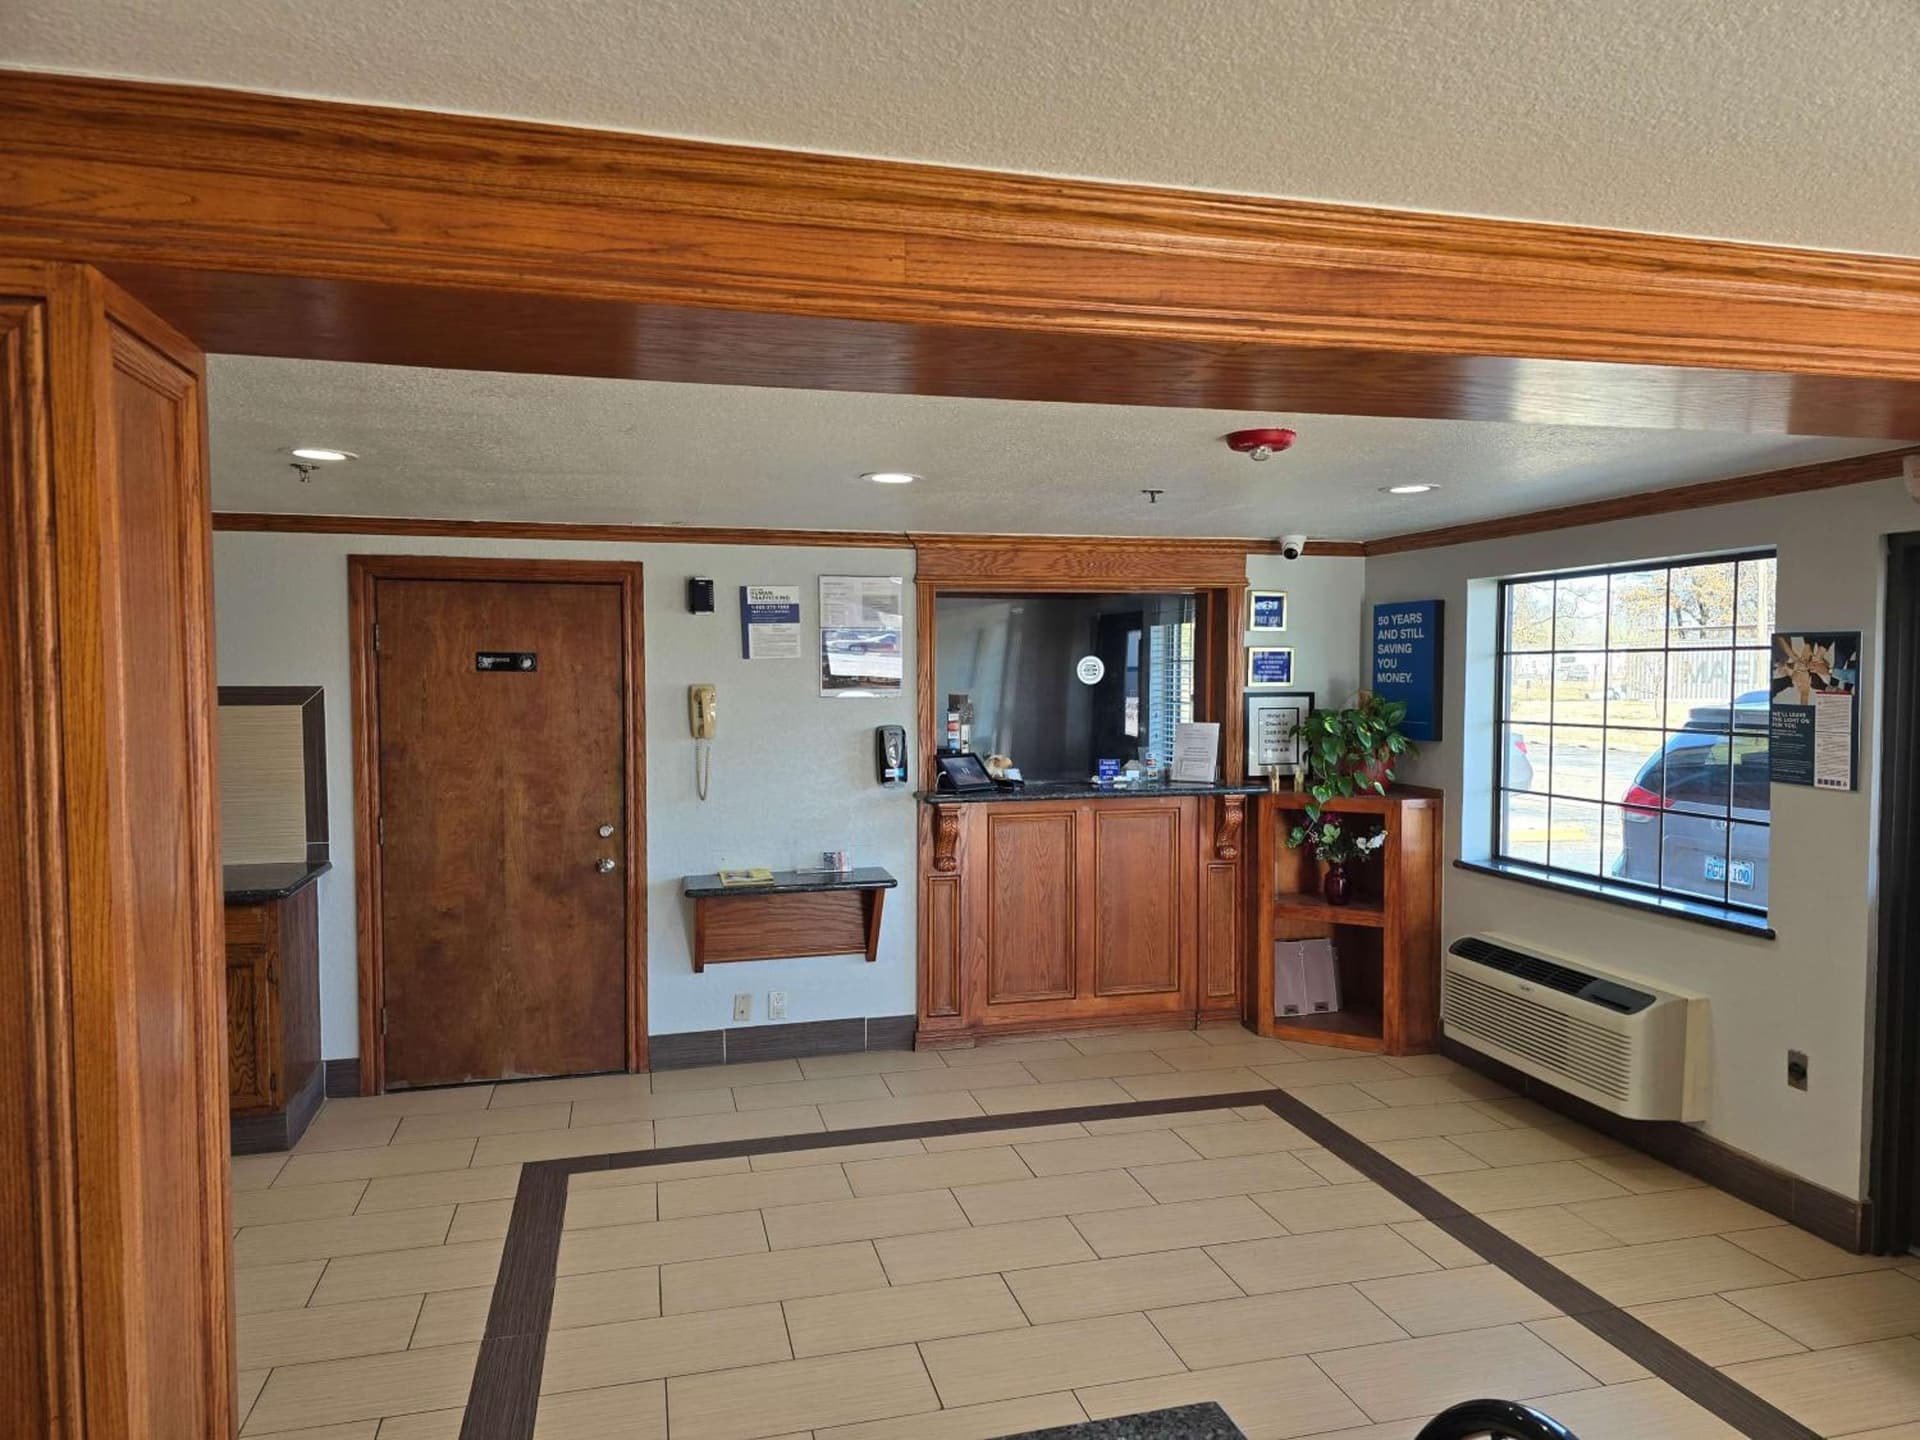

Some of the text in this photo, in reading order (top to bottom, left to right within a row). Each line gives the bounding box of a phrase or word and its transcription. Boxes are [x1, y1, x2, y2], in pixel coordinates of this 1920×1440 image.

[1377, 612, 1423, 626] 50 YEARS
[1377, 627, 1425, 640] AND STILL
[1377, 643, 1413, 655] SAVING
[1377, 658, 1398, 669] YOU
[1377, 672, 1414, 684] MONEY.
[1733, 868, 1750, 883] 100
